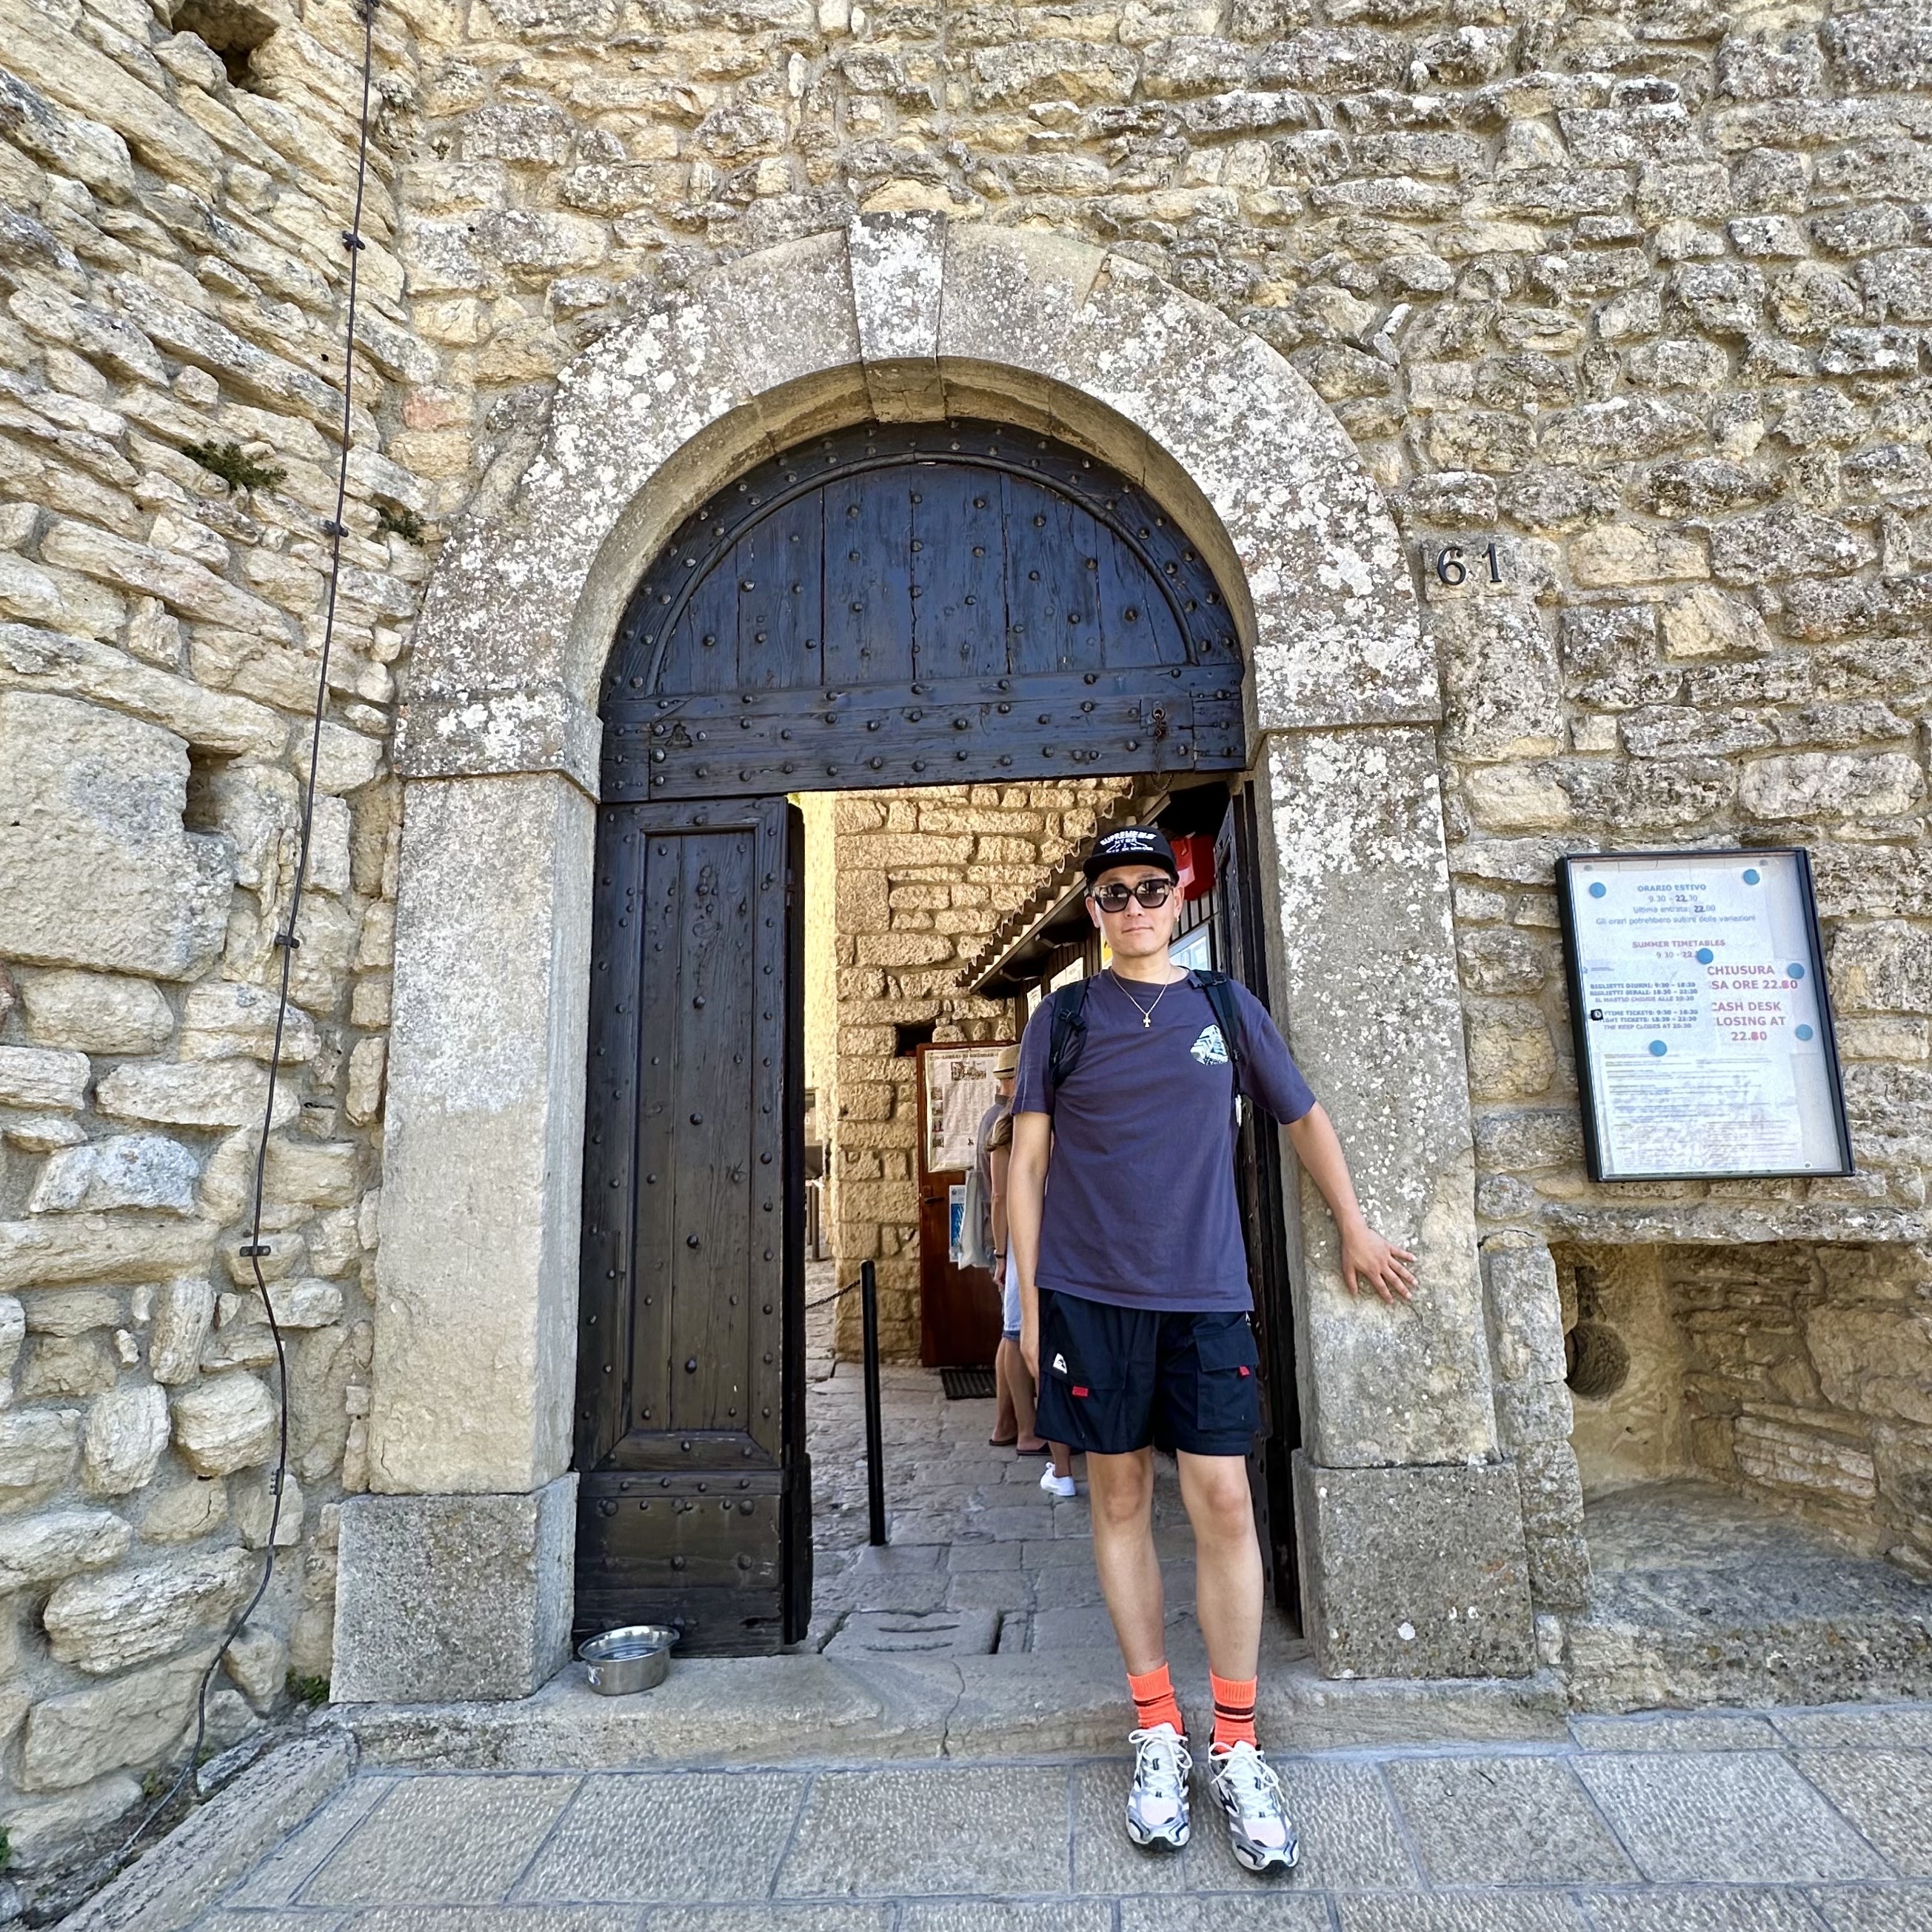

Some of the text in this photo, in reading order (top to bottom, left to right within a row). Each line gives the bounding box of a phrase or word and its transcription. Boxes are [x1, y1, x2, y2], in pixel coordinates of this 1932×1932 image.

[1437, 543, 1502, 586] 61
[1648, 895, 1666, 903] 9.30
[1629, 916, 1671, 926] potrebbero
[1671, 939, 1726, 947] TIMETABLES
[1707, 966, 1775, 975] CHIUSURA
[1709, 980, 1729, 989] SA
[1733, 980, 1759, 989] ORE
[1711, 1001, 1782, 1012] CASH DESK
[1713, 1016, 1786, 1026] LOSING AT
